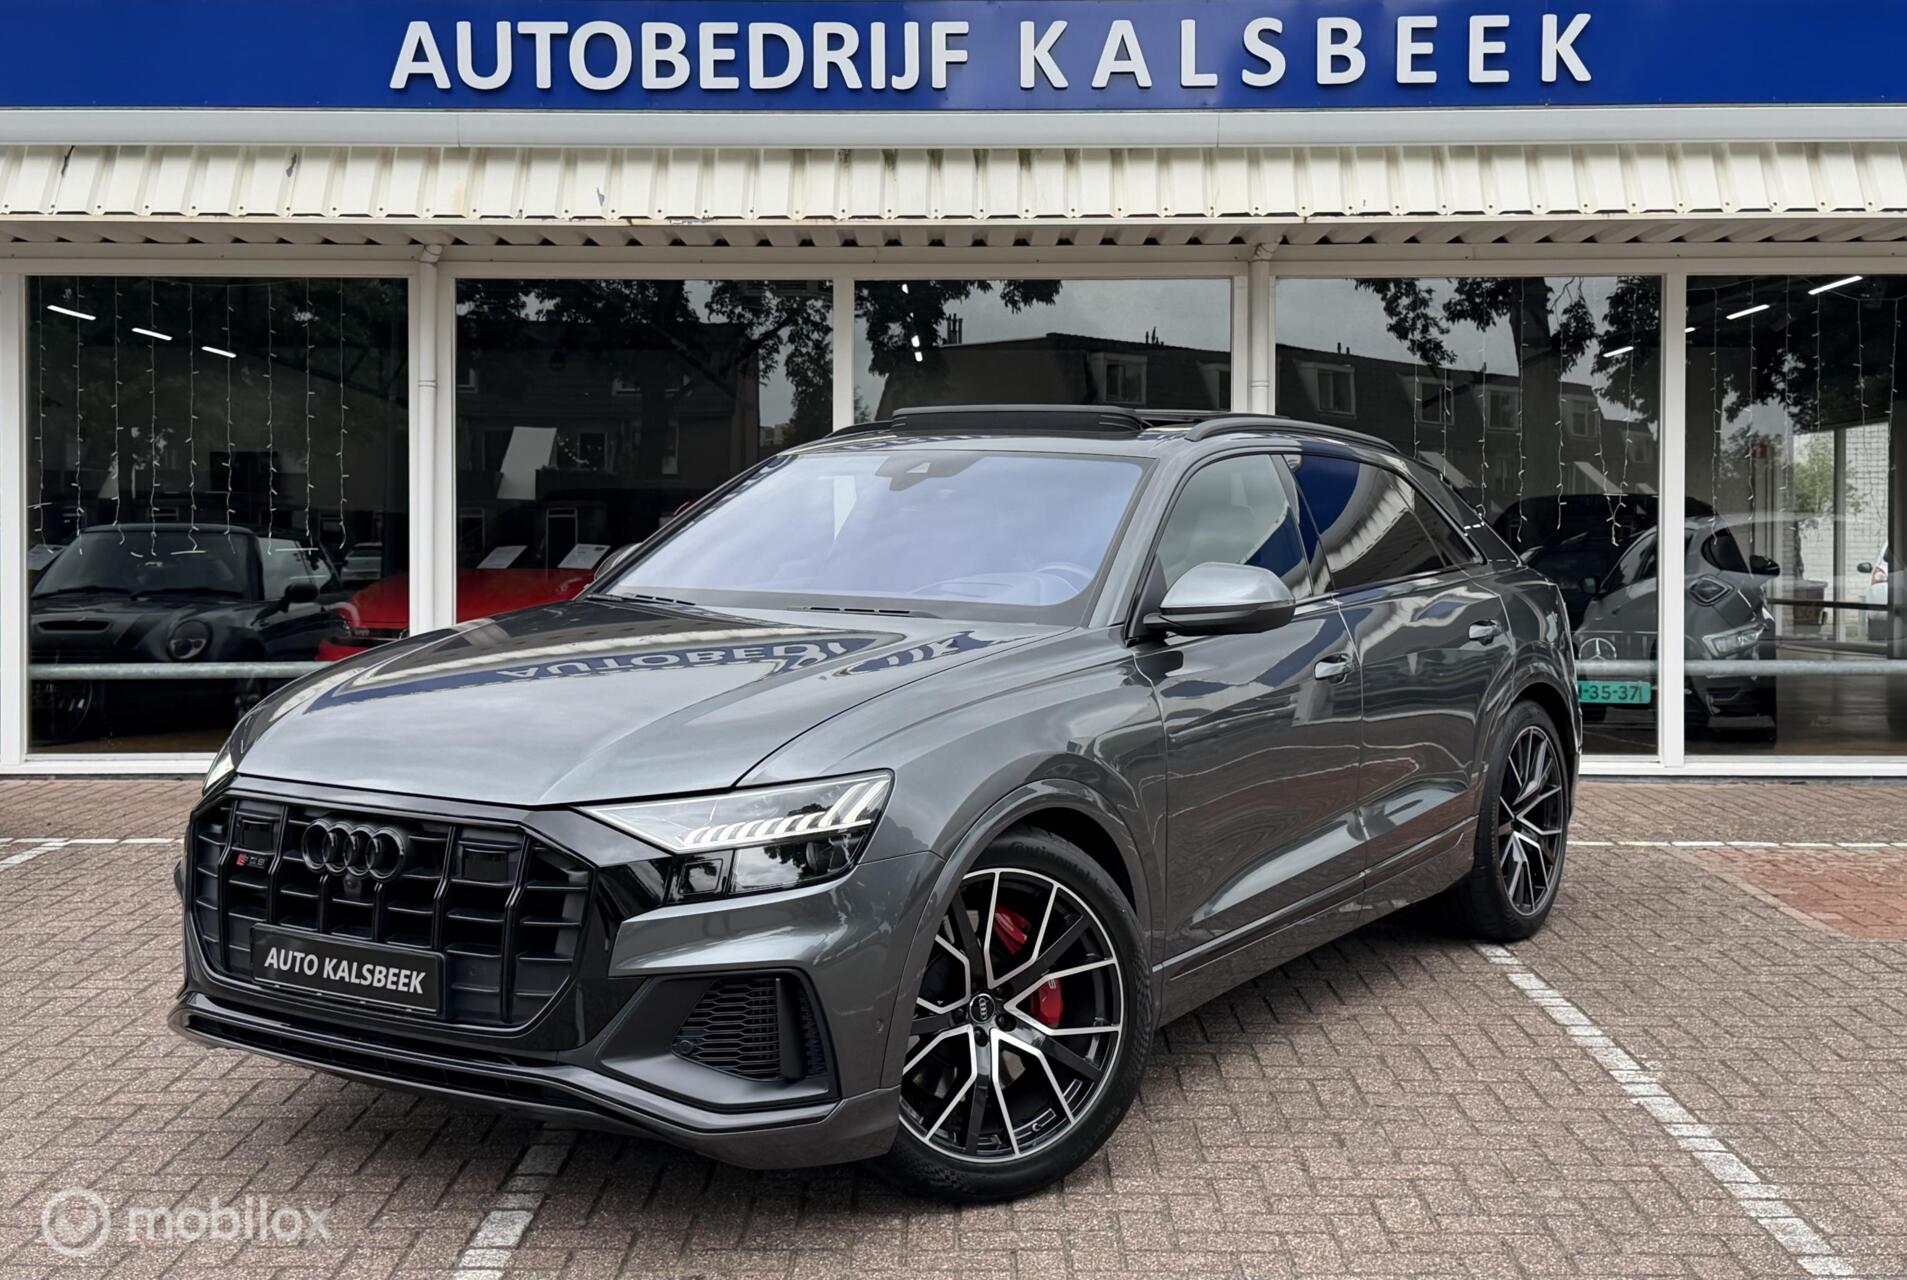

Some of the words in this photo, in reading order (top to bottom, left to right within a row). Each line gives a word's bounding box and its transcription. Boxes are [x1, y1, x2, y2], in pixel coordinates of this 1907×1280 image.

[389, 20, 970, 91] AUTOBEDRIJF
[1019, 13, 1592, 90] KALSBEEK
[263, 946, 319, 976] AUTO
[322, 957, 426, 995] KALSBEEK
